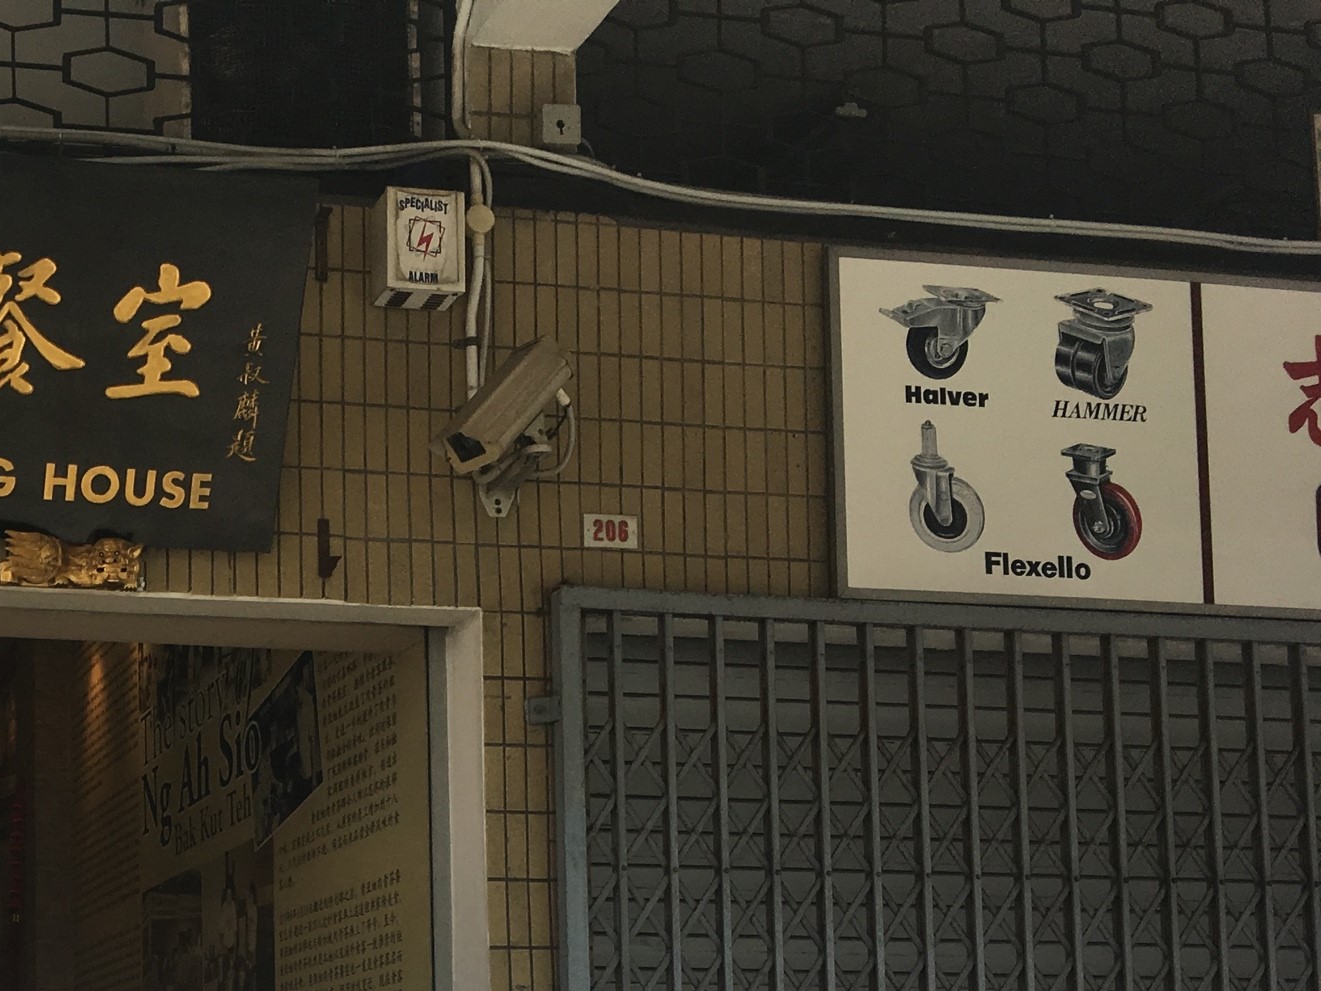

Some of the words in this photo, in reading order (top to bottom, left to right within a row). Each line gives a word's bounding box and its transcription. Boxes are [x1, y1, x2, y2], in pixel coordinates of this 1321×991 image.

[399, 196, 448, 214] SPECIALIST
[409, 271, 438, 283] ALARM
[905, 385, 989, 408] Halver
[1051, 400, 1147, 422] HAMMER
[43, 463, 214, 511] HOUSE
[593, 519, 629, 542] 206
[984, 552, 1091, 580] Flexello
[141, 765, 172, 848] Ng
[178, 730, 211, 813] Ah
[219, 709, 261, 788] Sio
[227, 784, 252, 826] Teh
